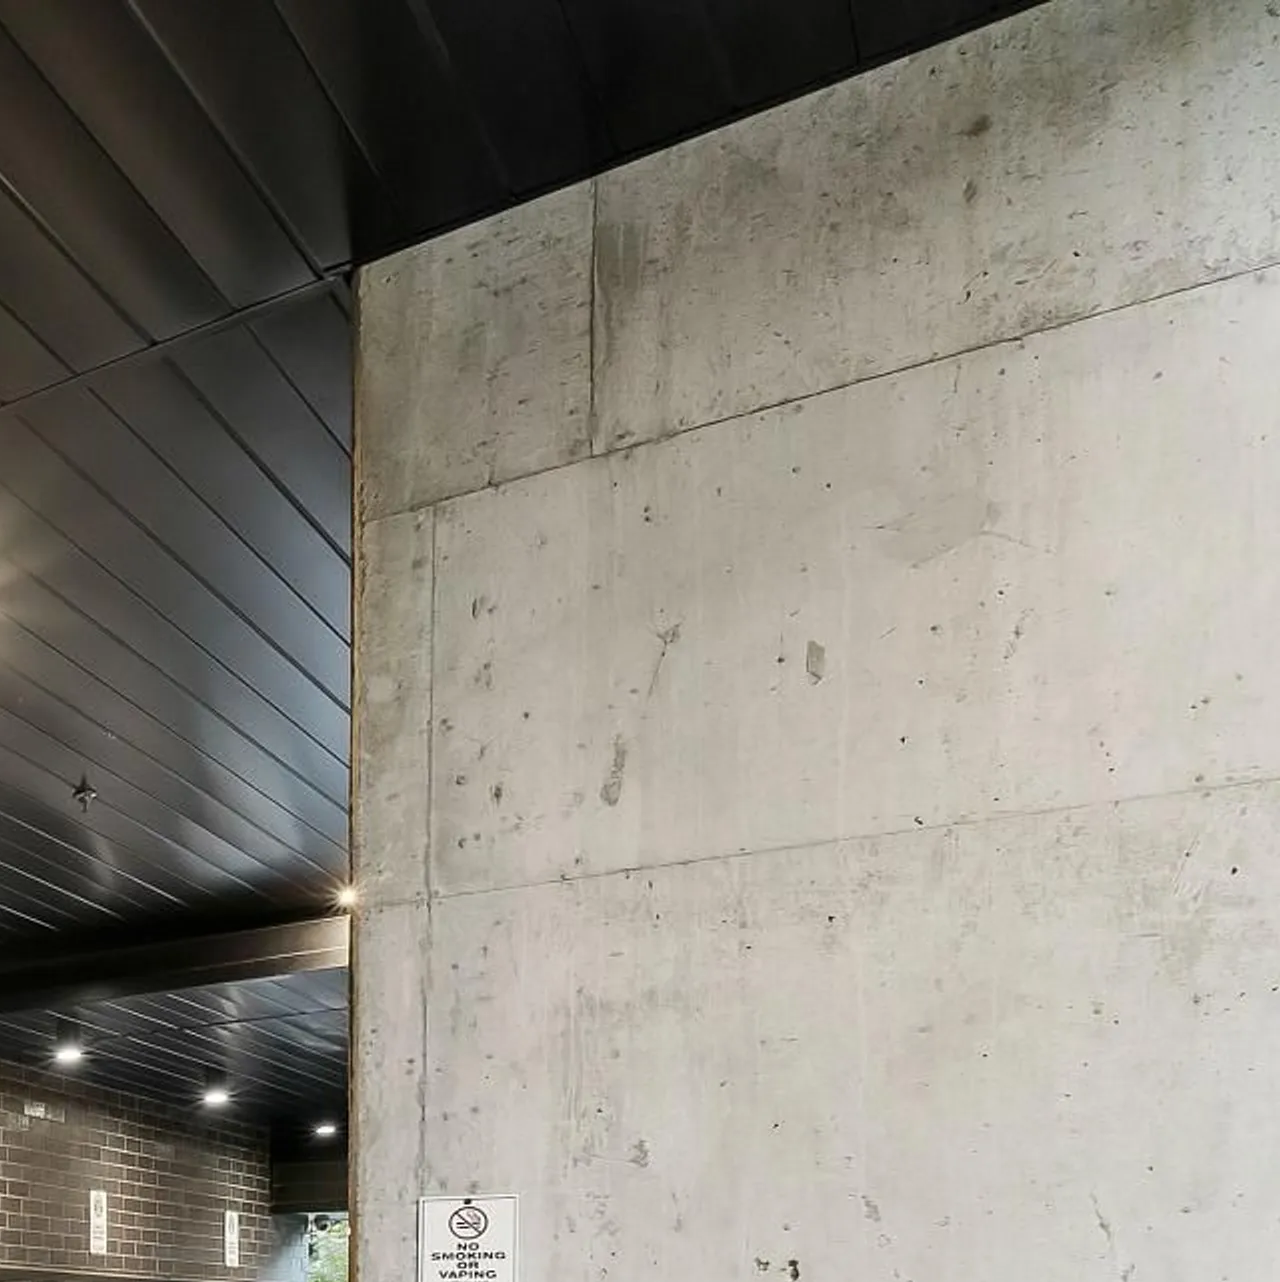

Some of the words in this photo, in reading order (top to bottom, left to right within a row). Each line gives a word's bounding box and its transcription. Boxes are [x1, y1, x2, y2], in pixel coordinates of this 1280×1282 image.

[457, 1242, 480, 1251] NO
[431, 1252, 506, 1261] SMOKING
[439, 1270, 497, 1279] VAPING
